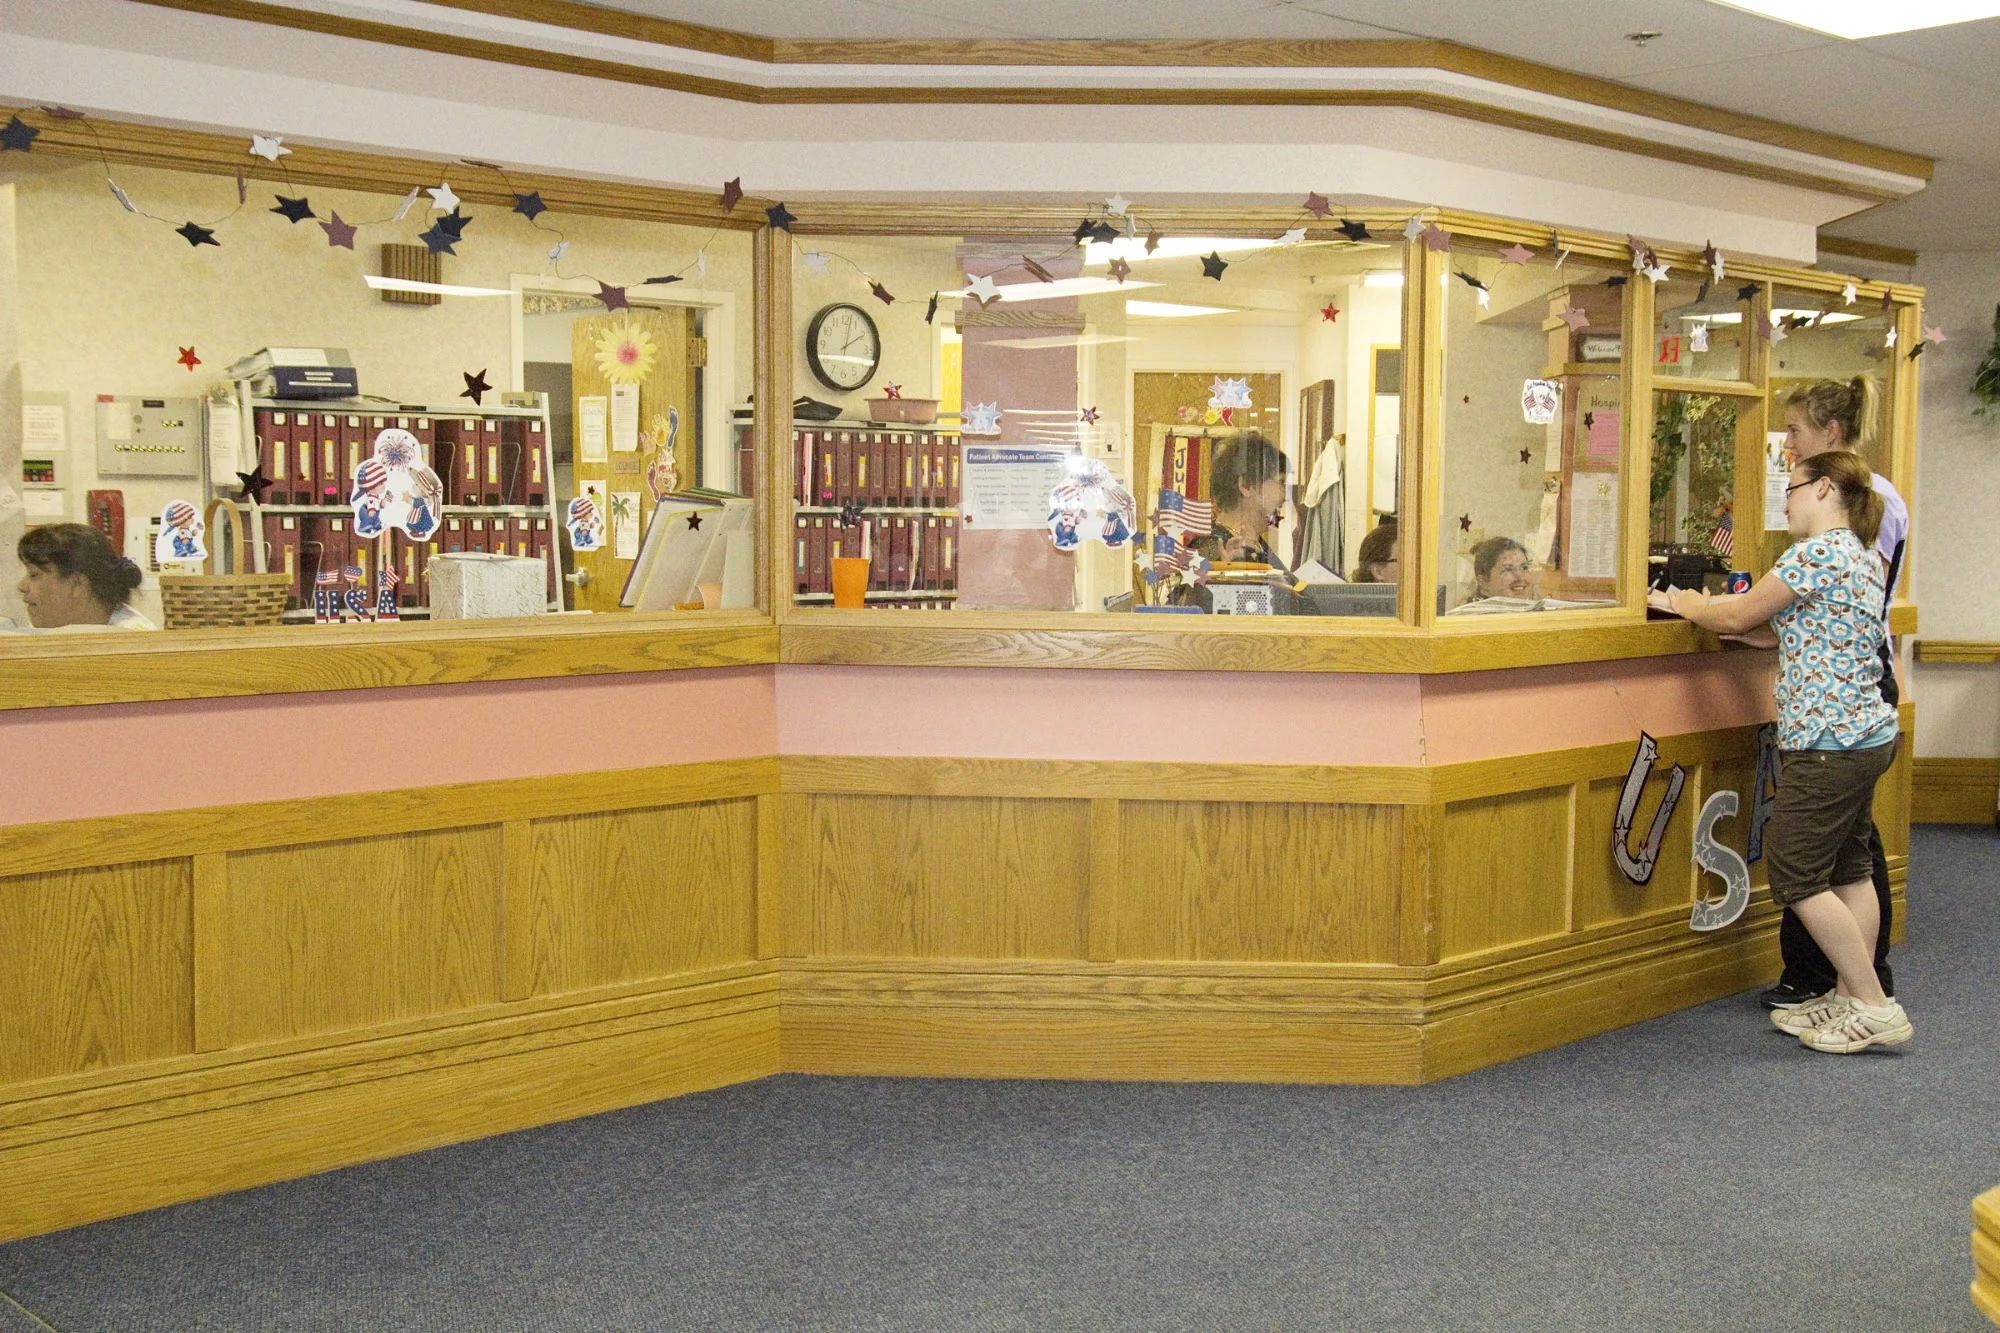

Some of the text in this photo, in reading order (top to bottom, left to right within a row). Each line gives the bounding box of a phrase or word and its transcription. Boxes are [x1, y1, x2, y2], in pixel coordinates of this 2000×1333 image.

[832, 317, 839, 328] 11
[841, 315, 850, 325] 12
[823, 326, 833, 337] 10
[314, 589, 400, 624] USA
